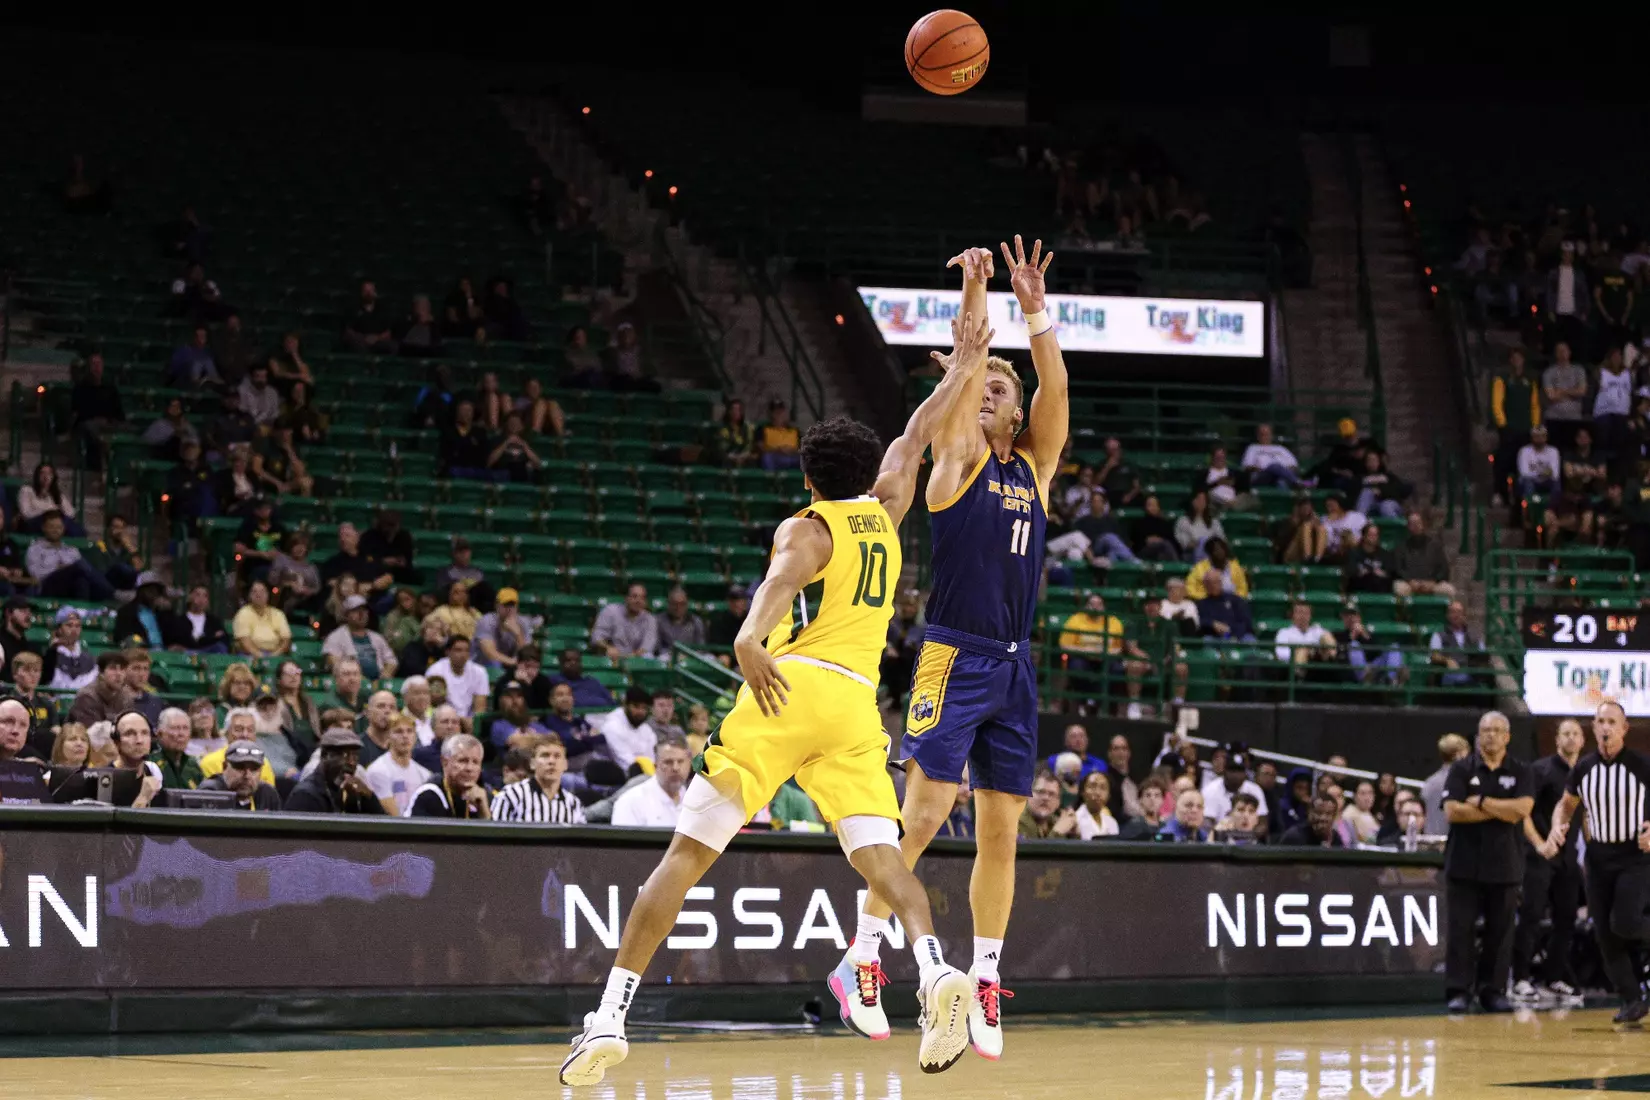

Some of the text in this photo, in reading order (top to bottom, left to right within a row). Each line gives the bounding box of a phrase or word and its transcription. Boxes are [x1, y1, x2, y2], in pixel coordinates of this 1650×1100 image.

[917, 296, 961, 320] Kin
[1058, 301, 1106, 330] King
[1197, 305, 1244, 334] King
[847, 514, 881, 534] DENNIS
[1010, 519, 1031, 556] 11
[852, 541, 887, 608] 10
[1553, 614, 1598, 643] 20
[1553, 660, 1609, 691] Tow
[0, 875, 98, 947] N
[564, 885, 905, 949] NSSA
[1208, 893, 1438, 947] NISSAN
